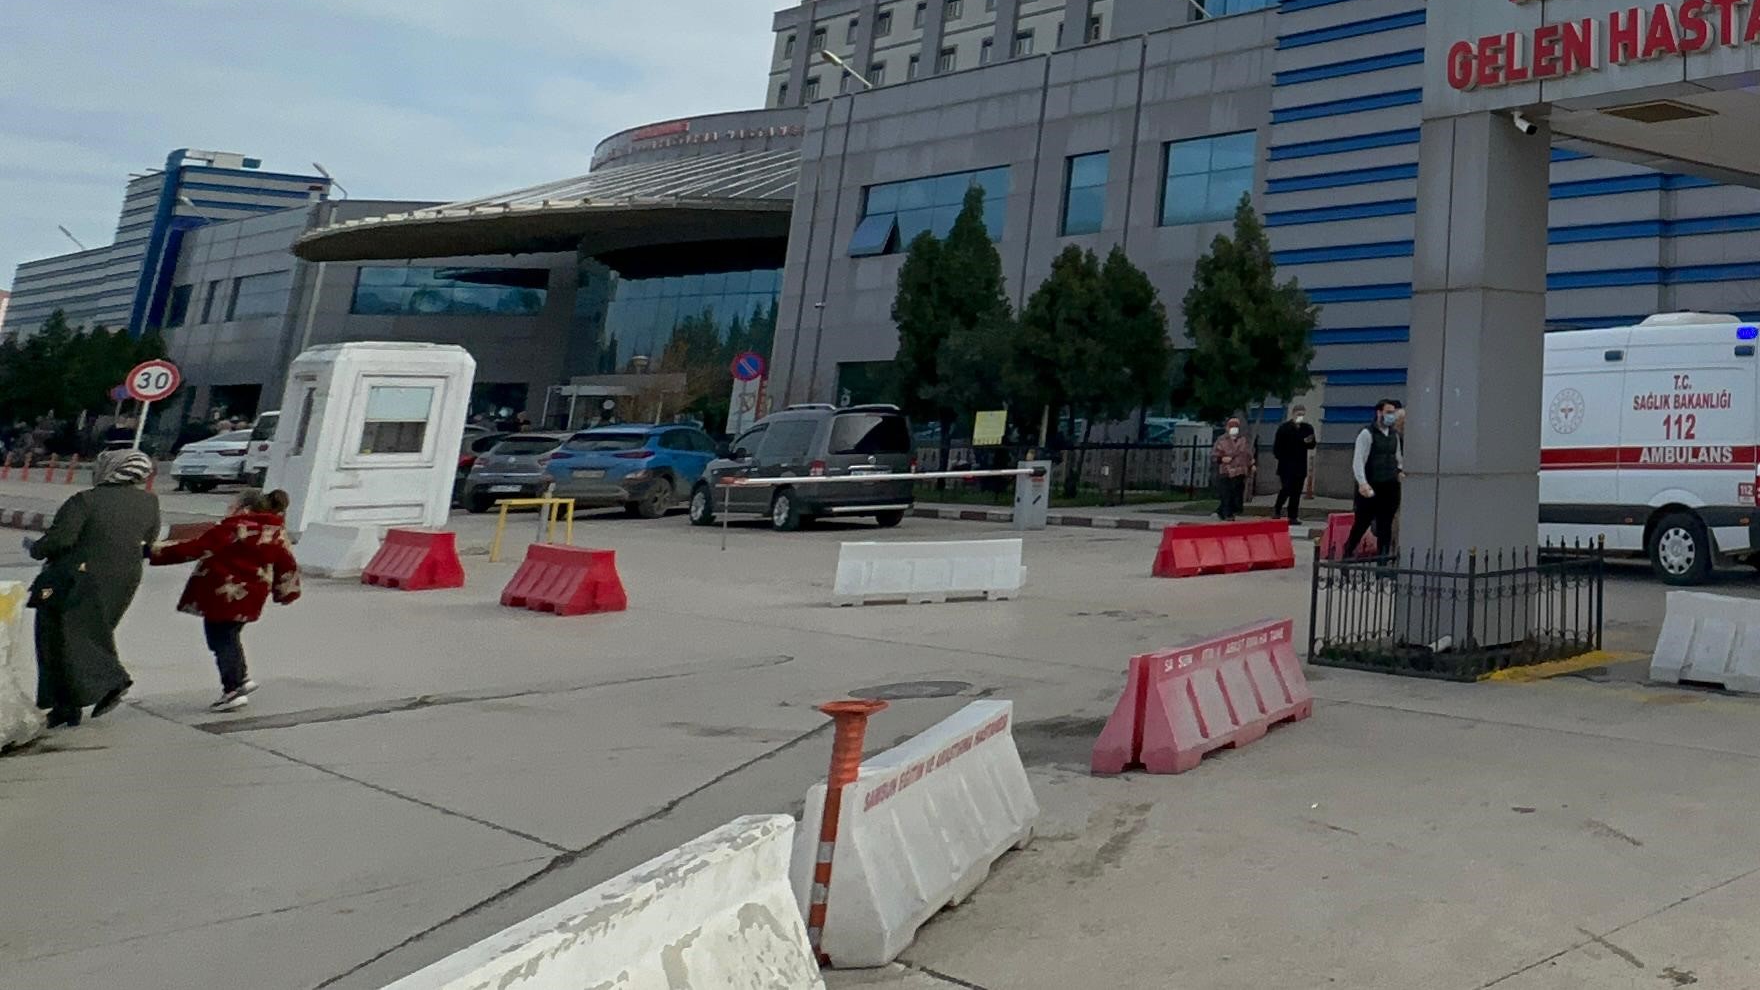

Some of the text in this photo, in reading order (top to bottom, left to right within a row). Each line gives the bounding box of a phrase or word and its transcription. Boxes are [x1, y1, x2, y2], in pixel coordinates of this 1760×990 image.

[1447, 17, 1598, 91] GELEN
[137, 372, 169, 390] 30
[1673, 375, 1692, 390] T.C.
[1633, 390, 1732, 410] SAĞLIK BAKANLIĞI
[1663, 414, 1696, 440] 112
[1640, 445, 1733, 463] AMBULANS
